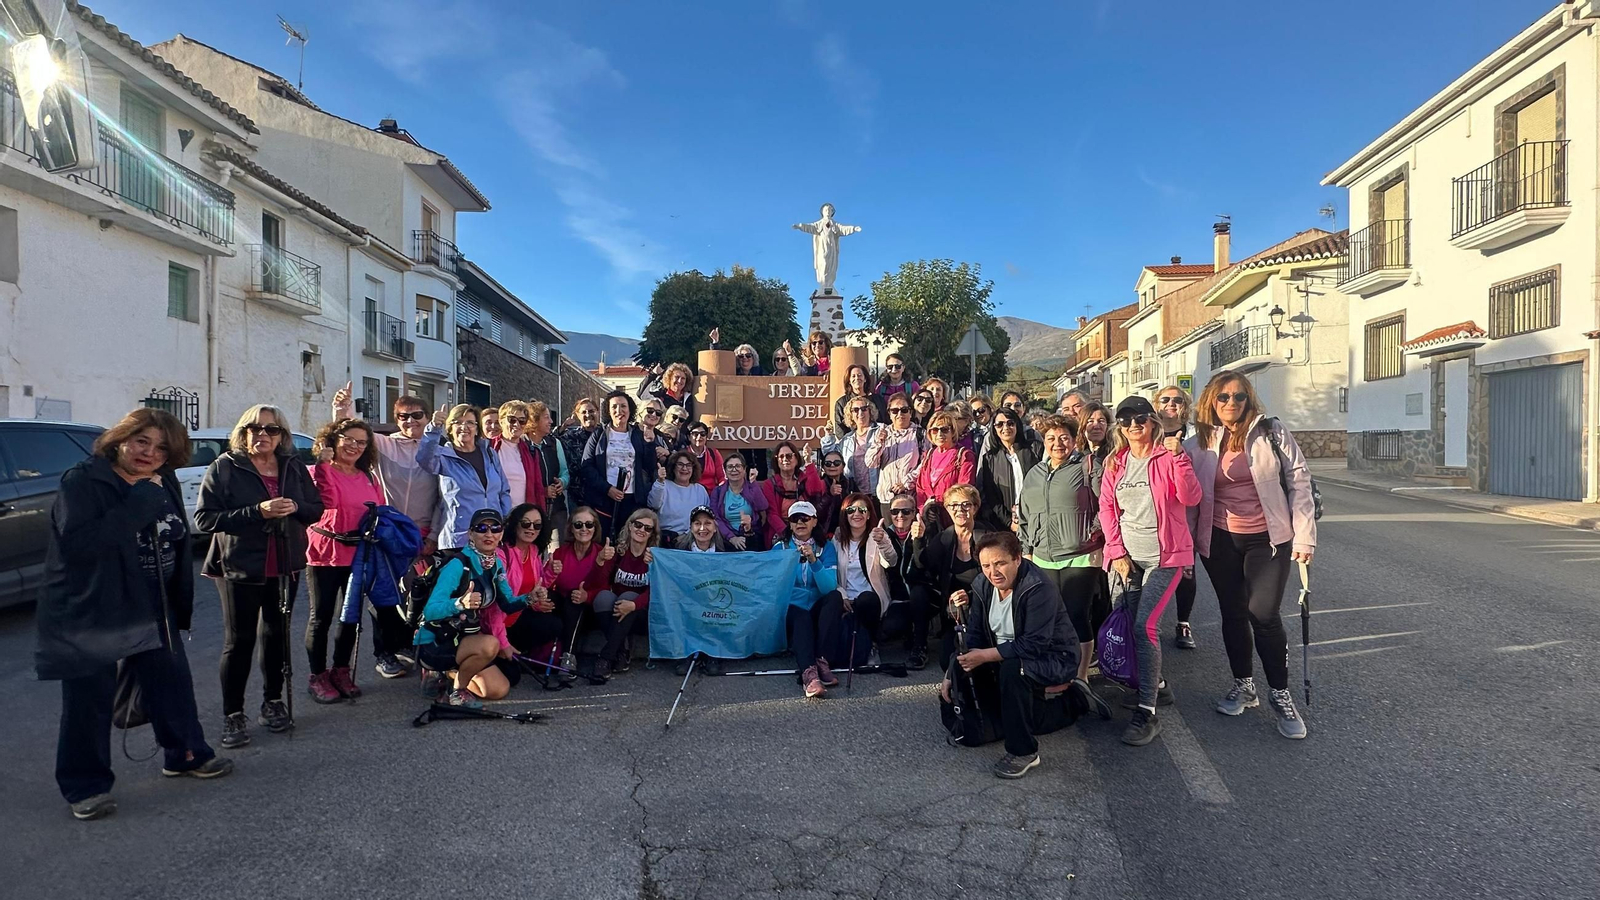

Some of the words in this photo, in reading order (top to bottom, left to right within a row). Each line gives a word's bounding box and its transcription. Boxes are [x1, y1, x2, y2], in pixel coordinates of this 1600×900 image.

[768, 383, 829, 398] JEREZ
[791, 404, 829, 419] DEL
[707, 424, 827, 444] ARQUESADO
